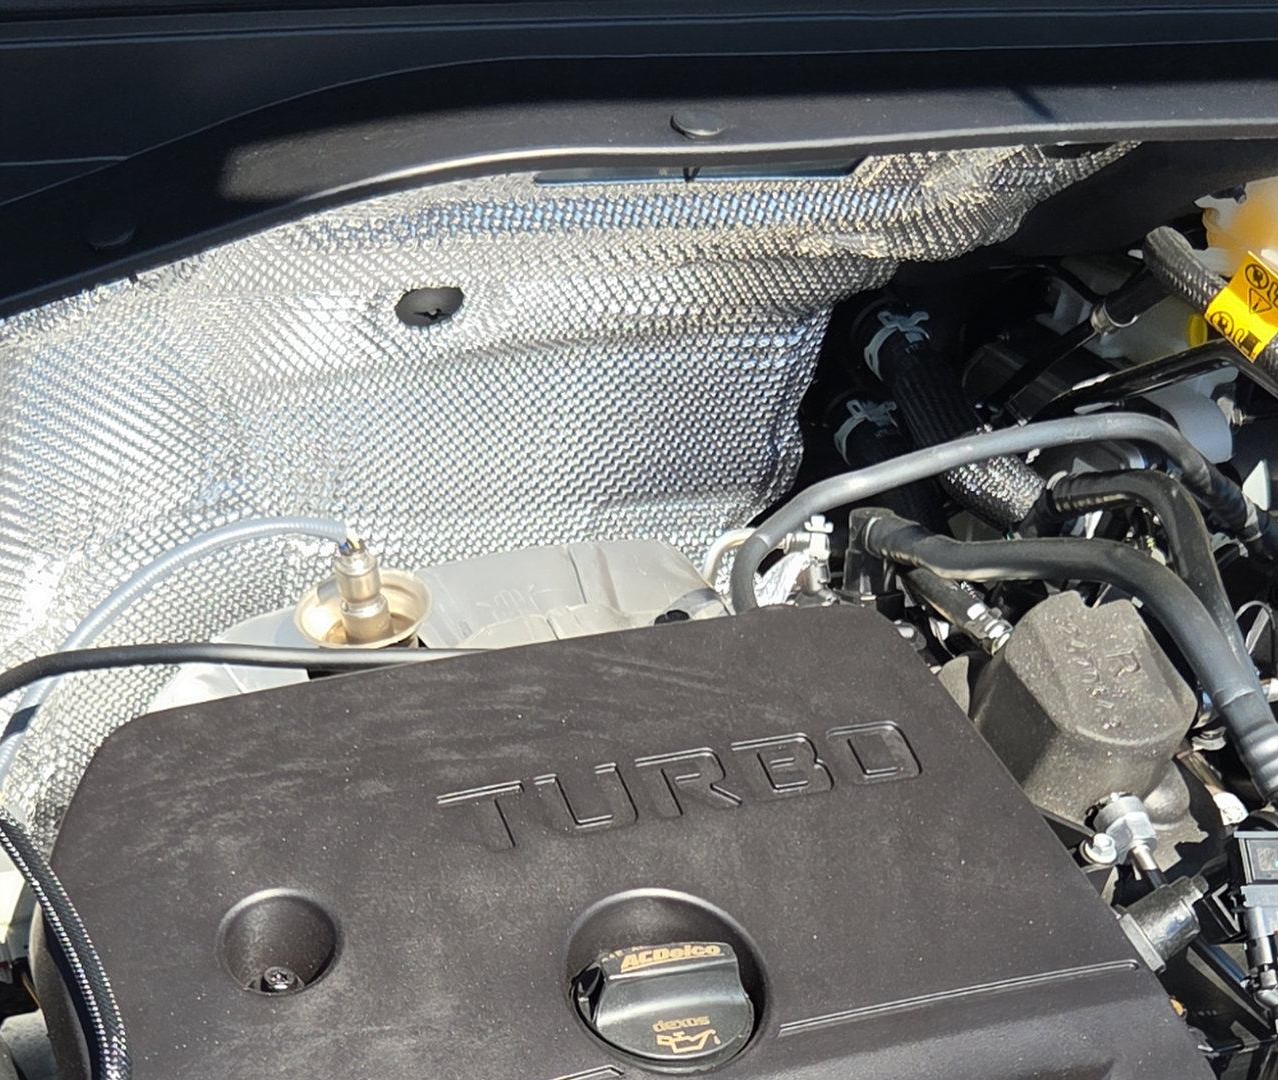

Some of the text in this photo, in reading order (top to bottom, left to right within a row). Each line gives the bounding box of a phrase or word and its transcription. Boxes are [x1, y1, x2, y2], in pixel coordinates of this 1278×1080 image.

[436, 720, 924, 851] TURBO
[620, 944, 723, 971] ACDelco
[653, 1016, 710, 1032] dexos
